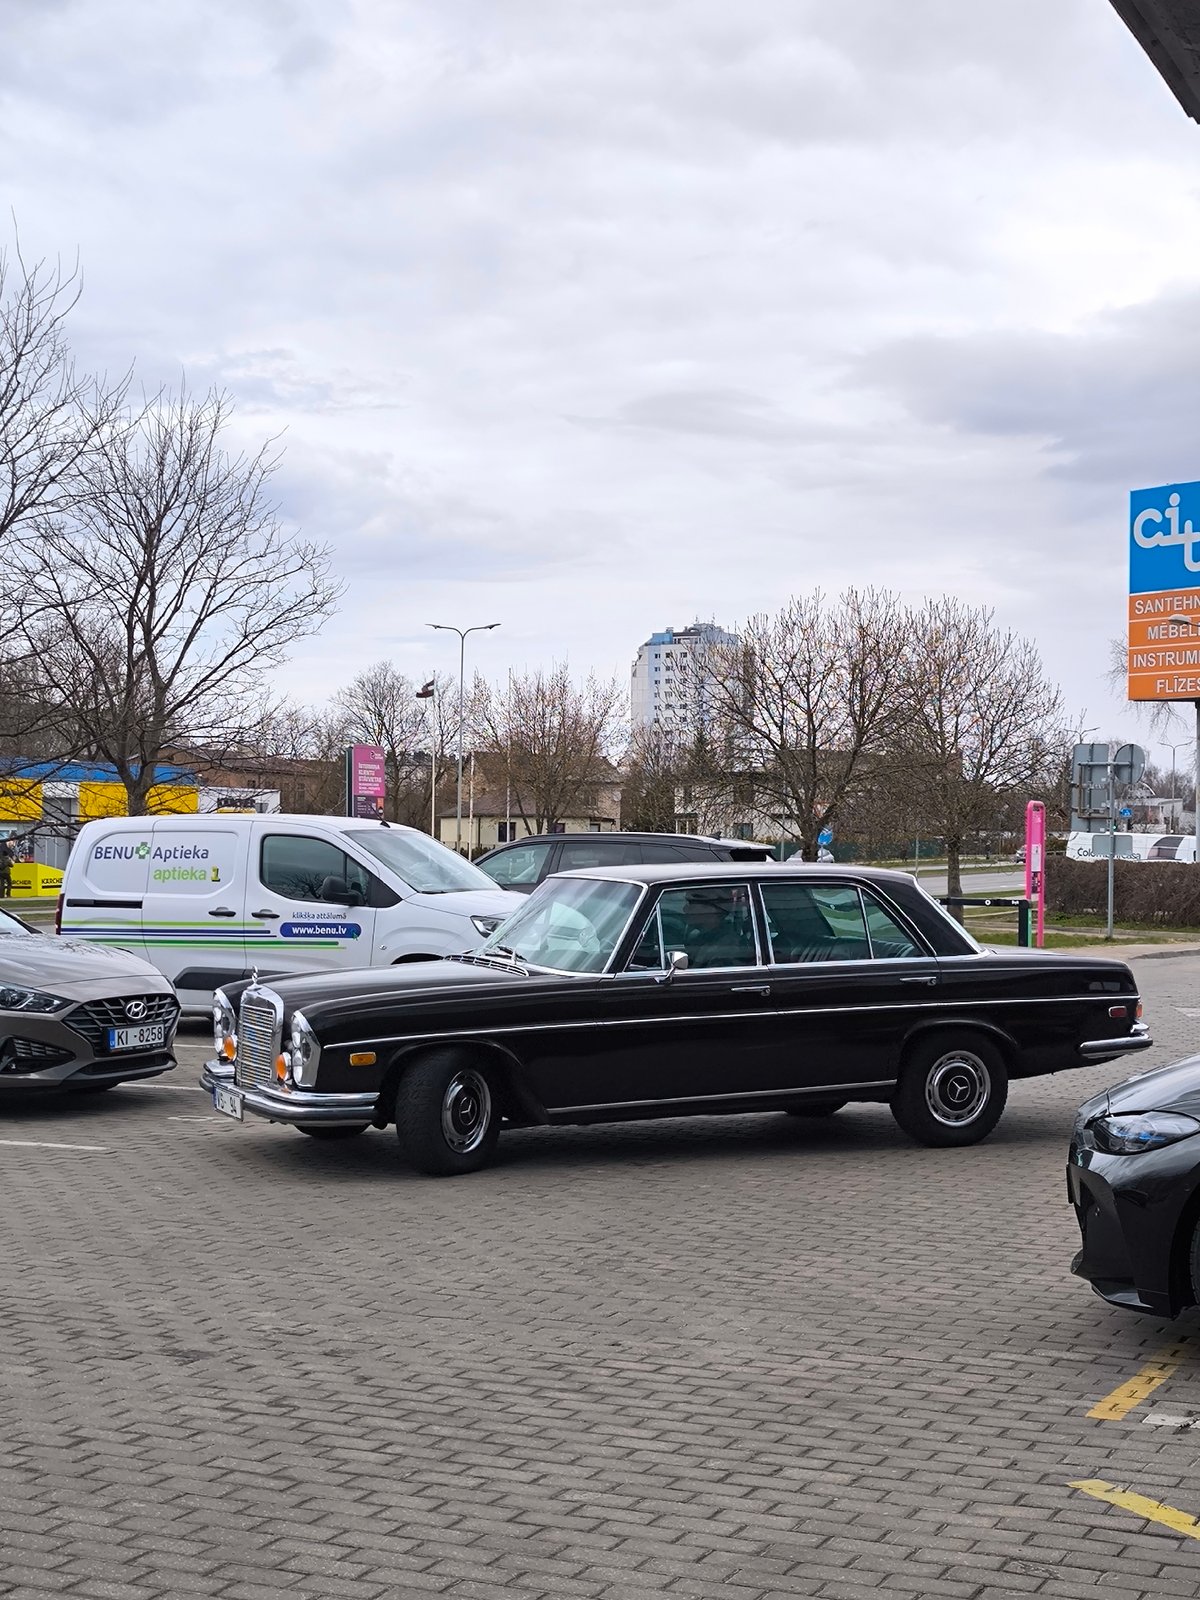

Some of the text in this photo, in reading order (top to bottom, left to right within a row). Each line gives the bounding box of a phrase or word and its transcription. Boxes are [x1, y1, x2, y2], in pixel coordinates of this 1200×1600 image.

[1135, 595, 1200, 614] SANTEHN
[1147, 622, 1200, 640] MĒBEL
[1133, 650, 1200, 668] INSTRUM
[94, 845, 209, 863] BENU Aptieka
[153, 866, 207, 884] aptieka
[291, 925, 347, 935] www.benu.lv
